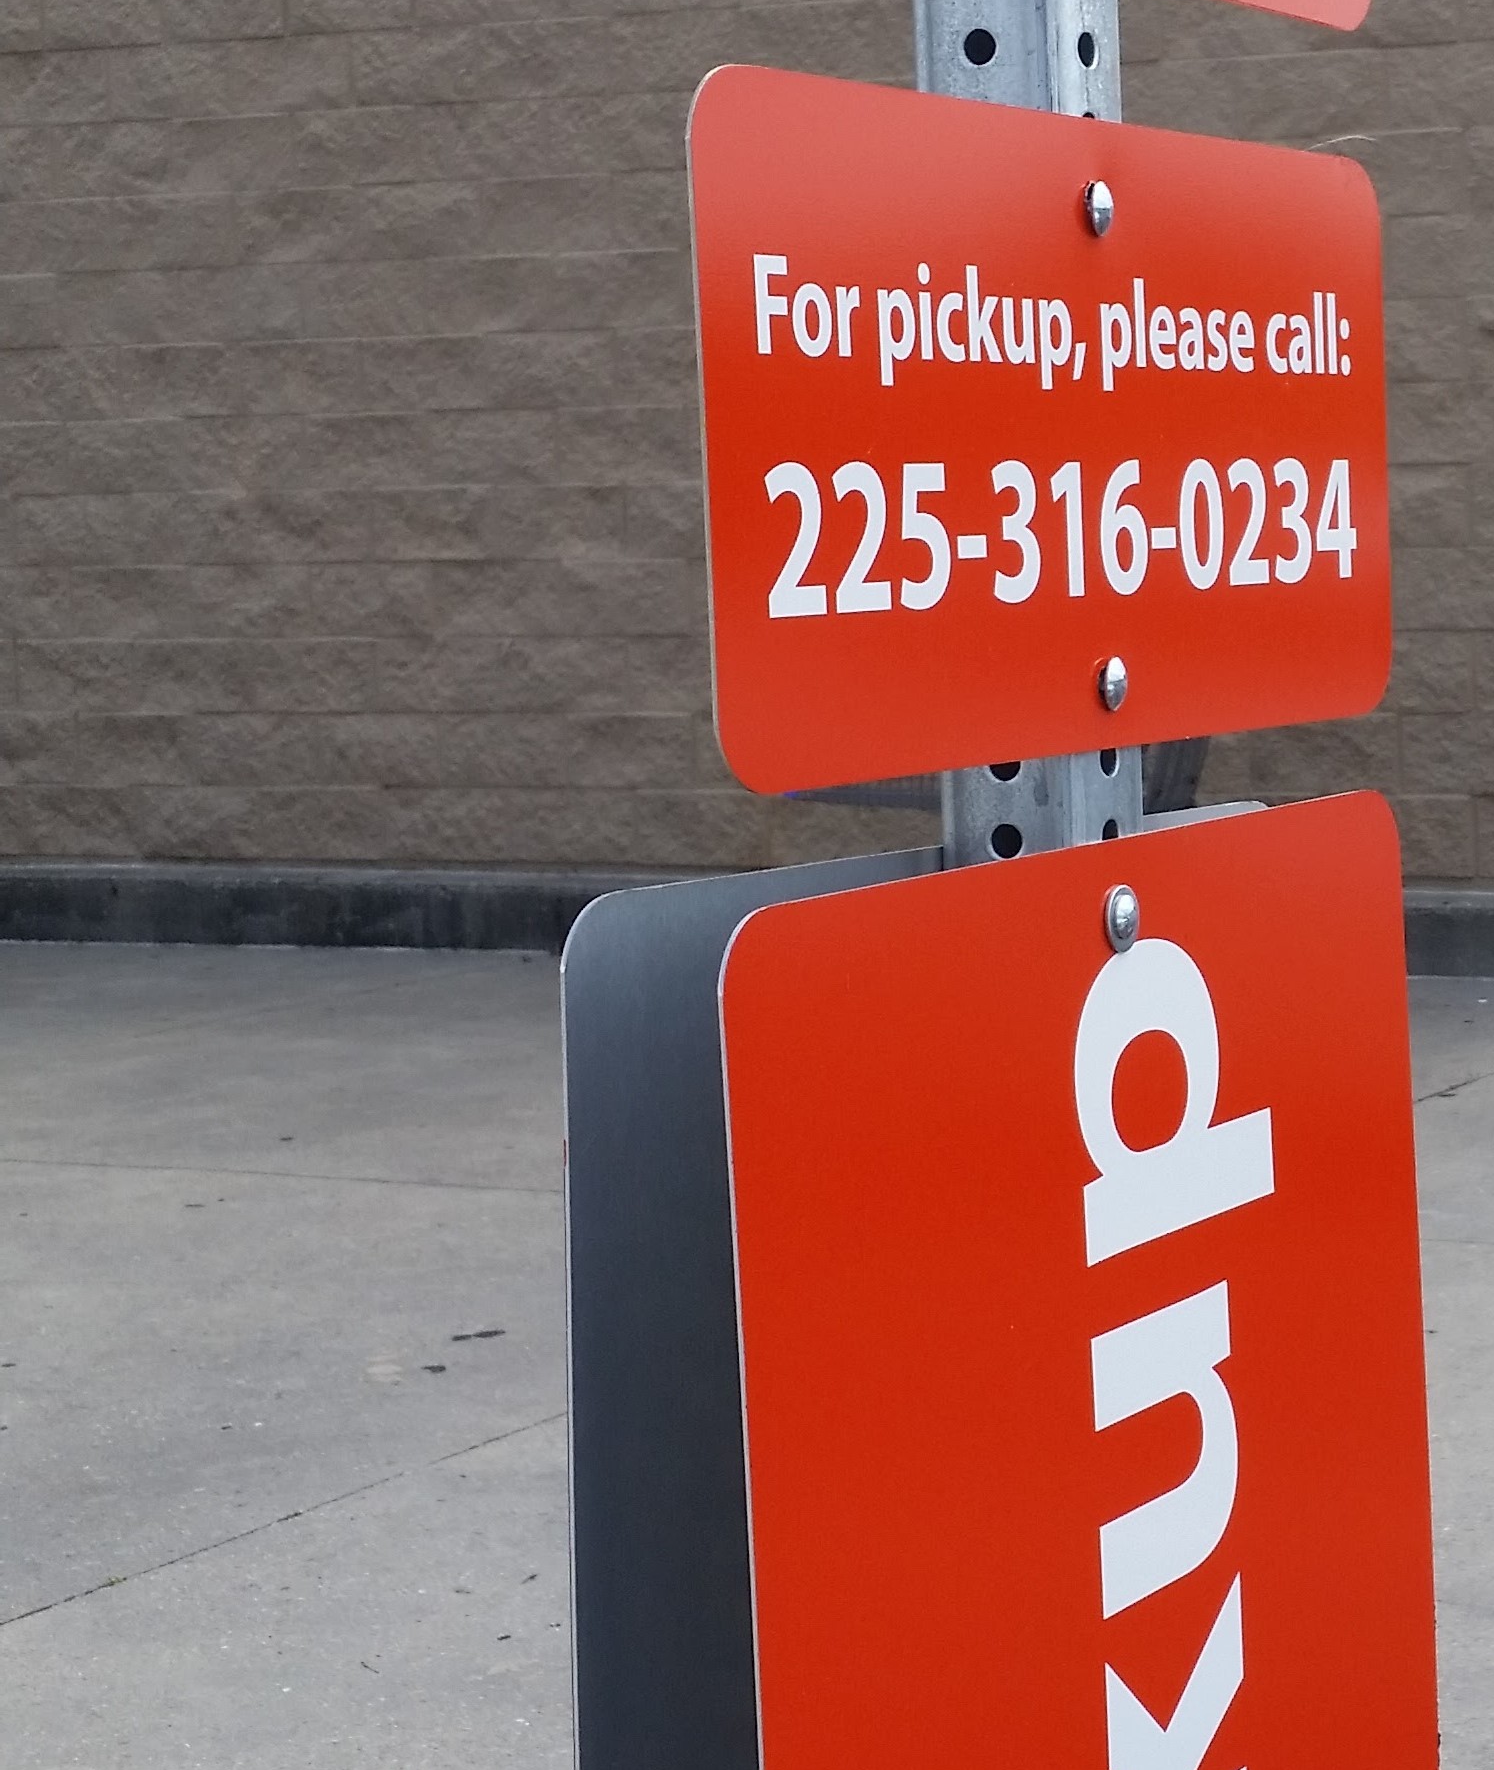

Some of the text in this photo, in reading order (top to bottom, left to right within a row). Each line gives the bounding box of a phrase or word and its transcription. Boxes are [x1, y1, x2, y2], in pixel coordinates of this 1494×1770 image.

[752, 252, 1352, 392] For pickup, please call:
[764, 458, 1357, 619] 225-316-0234
